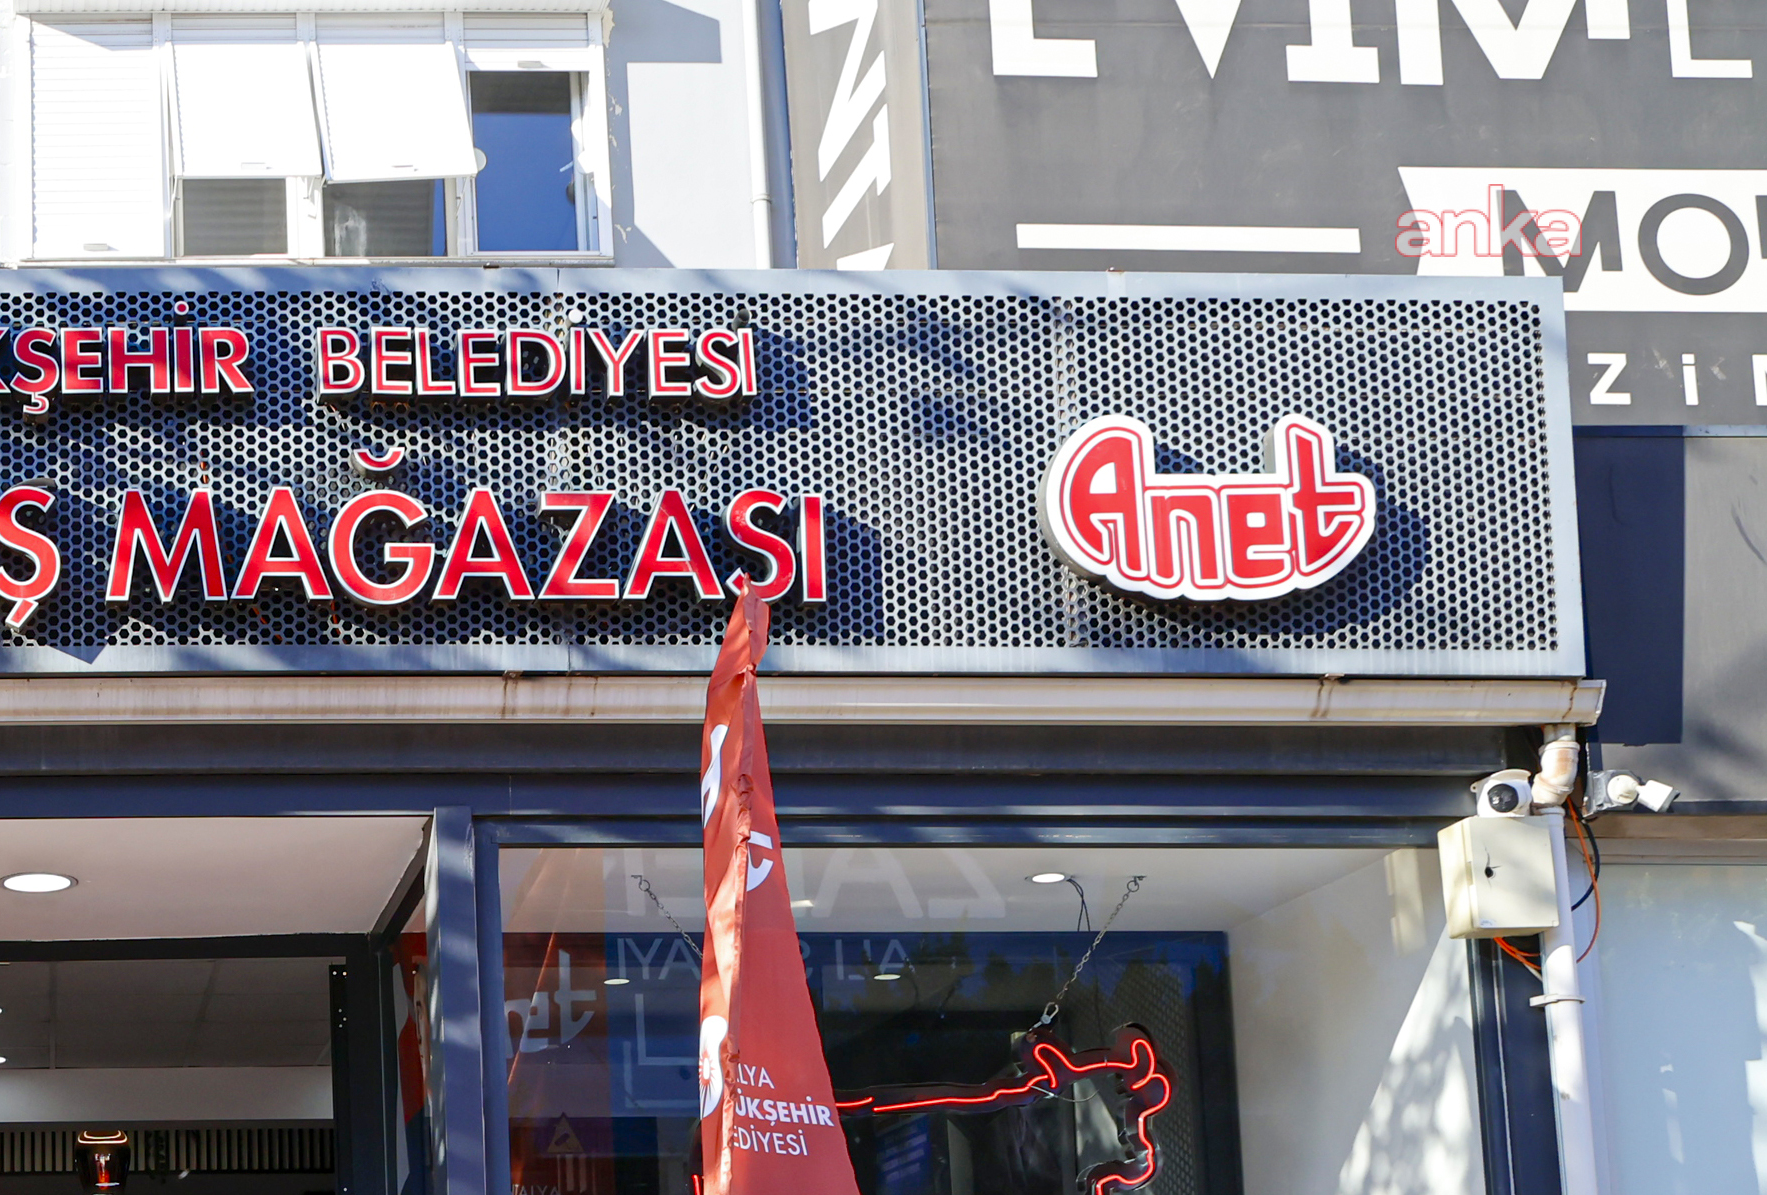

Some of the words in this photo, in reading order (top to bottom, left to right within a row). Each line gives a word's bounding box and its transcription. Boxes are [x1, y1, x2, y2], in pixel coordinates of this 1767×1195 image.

[1496, 189, 1767, 296] MO
[315, 308, 759, 401] BELEDİYESİ
[106, 447, 828, 604] MAĞAZASI
[1061, 420, 1367, 592] Anet
